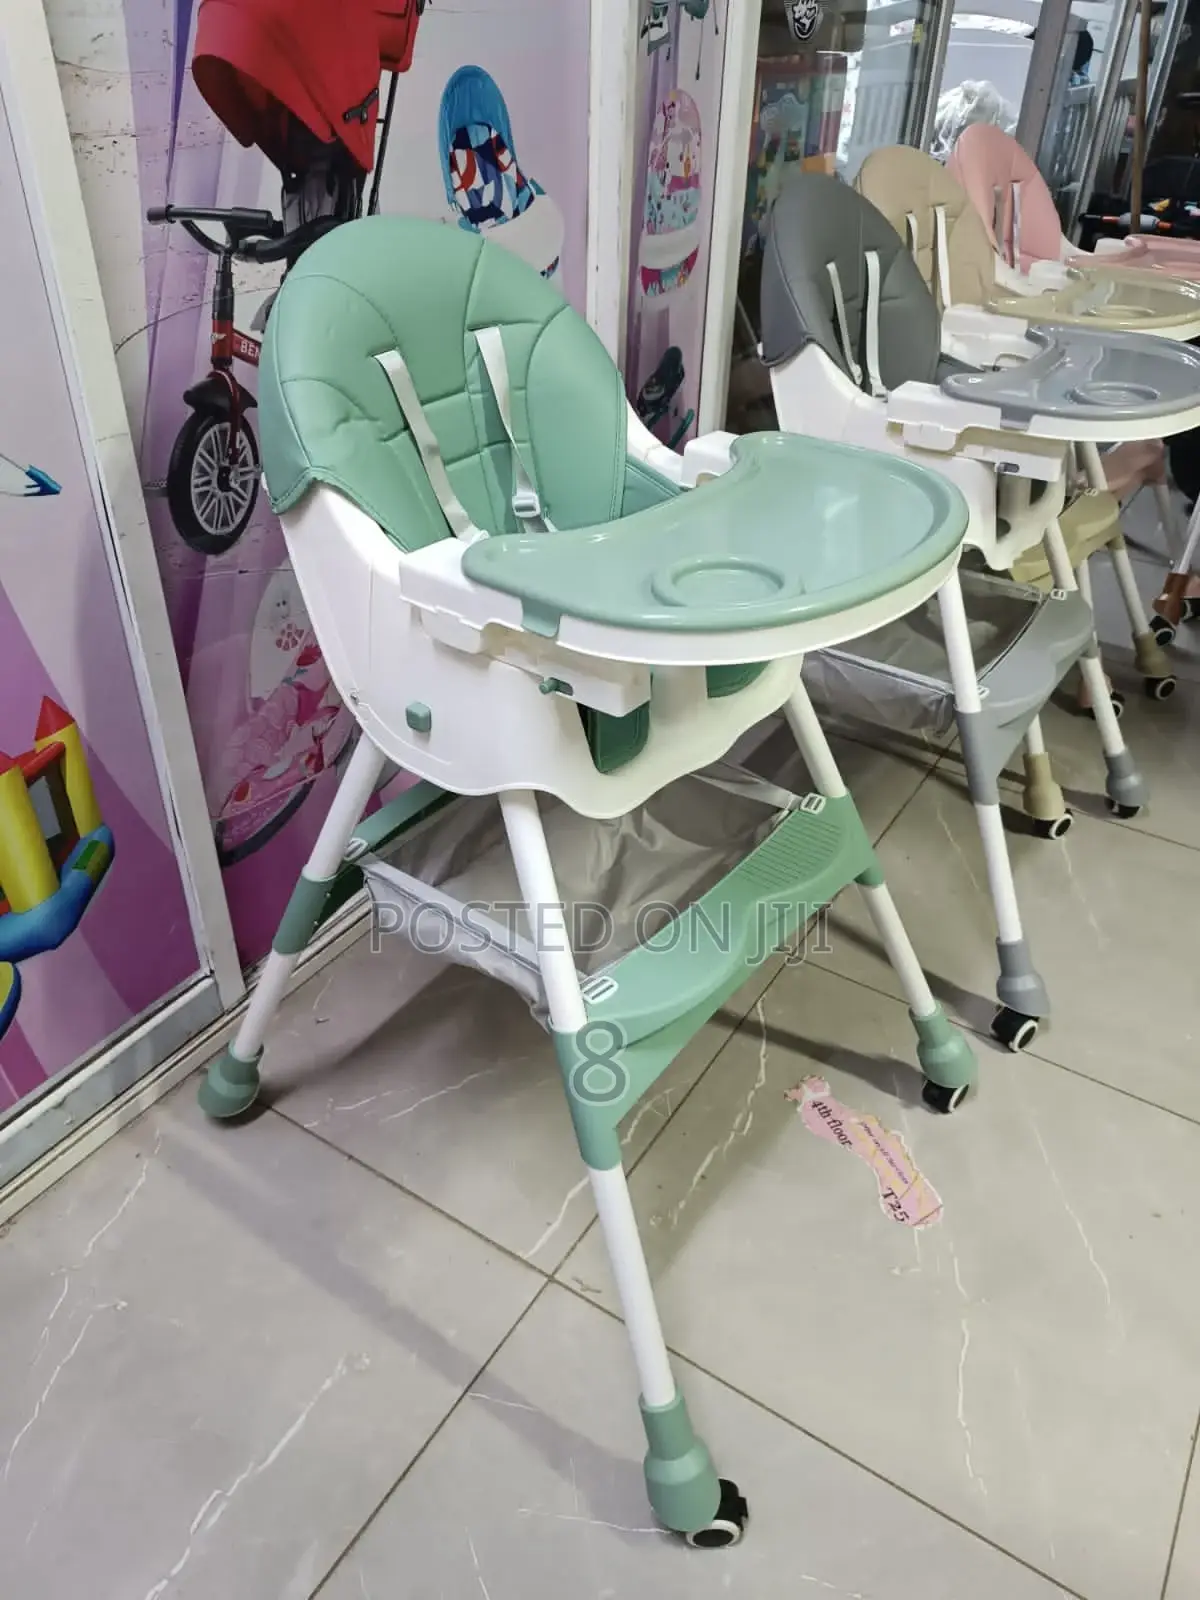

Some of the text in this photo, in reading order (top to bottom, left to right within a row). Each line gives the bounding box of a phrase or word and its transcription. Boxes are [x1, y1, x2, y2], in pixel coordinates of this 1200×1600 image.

[811, 1100, 853, 1149] 4th floor
[883, 1187, 909, 1222] T25
